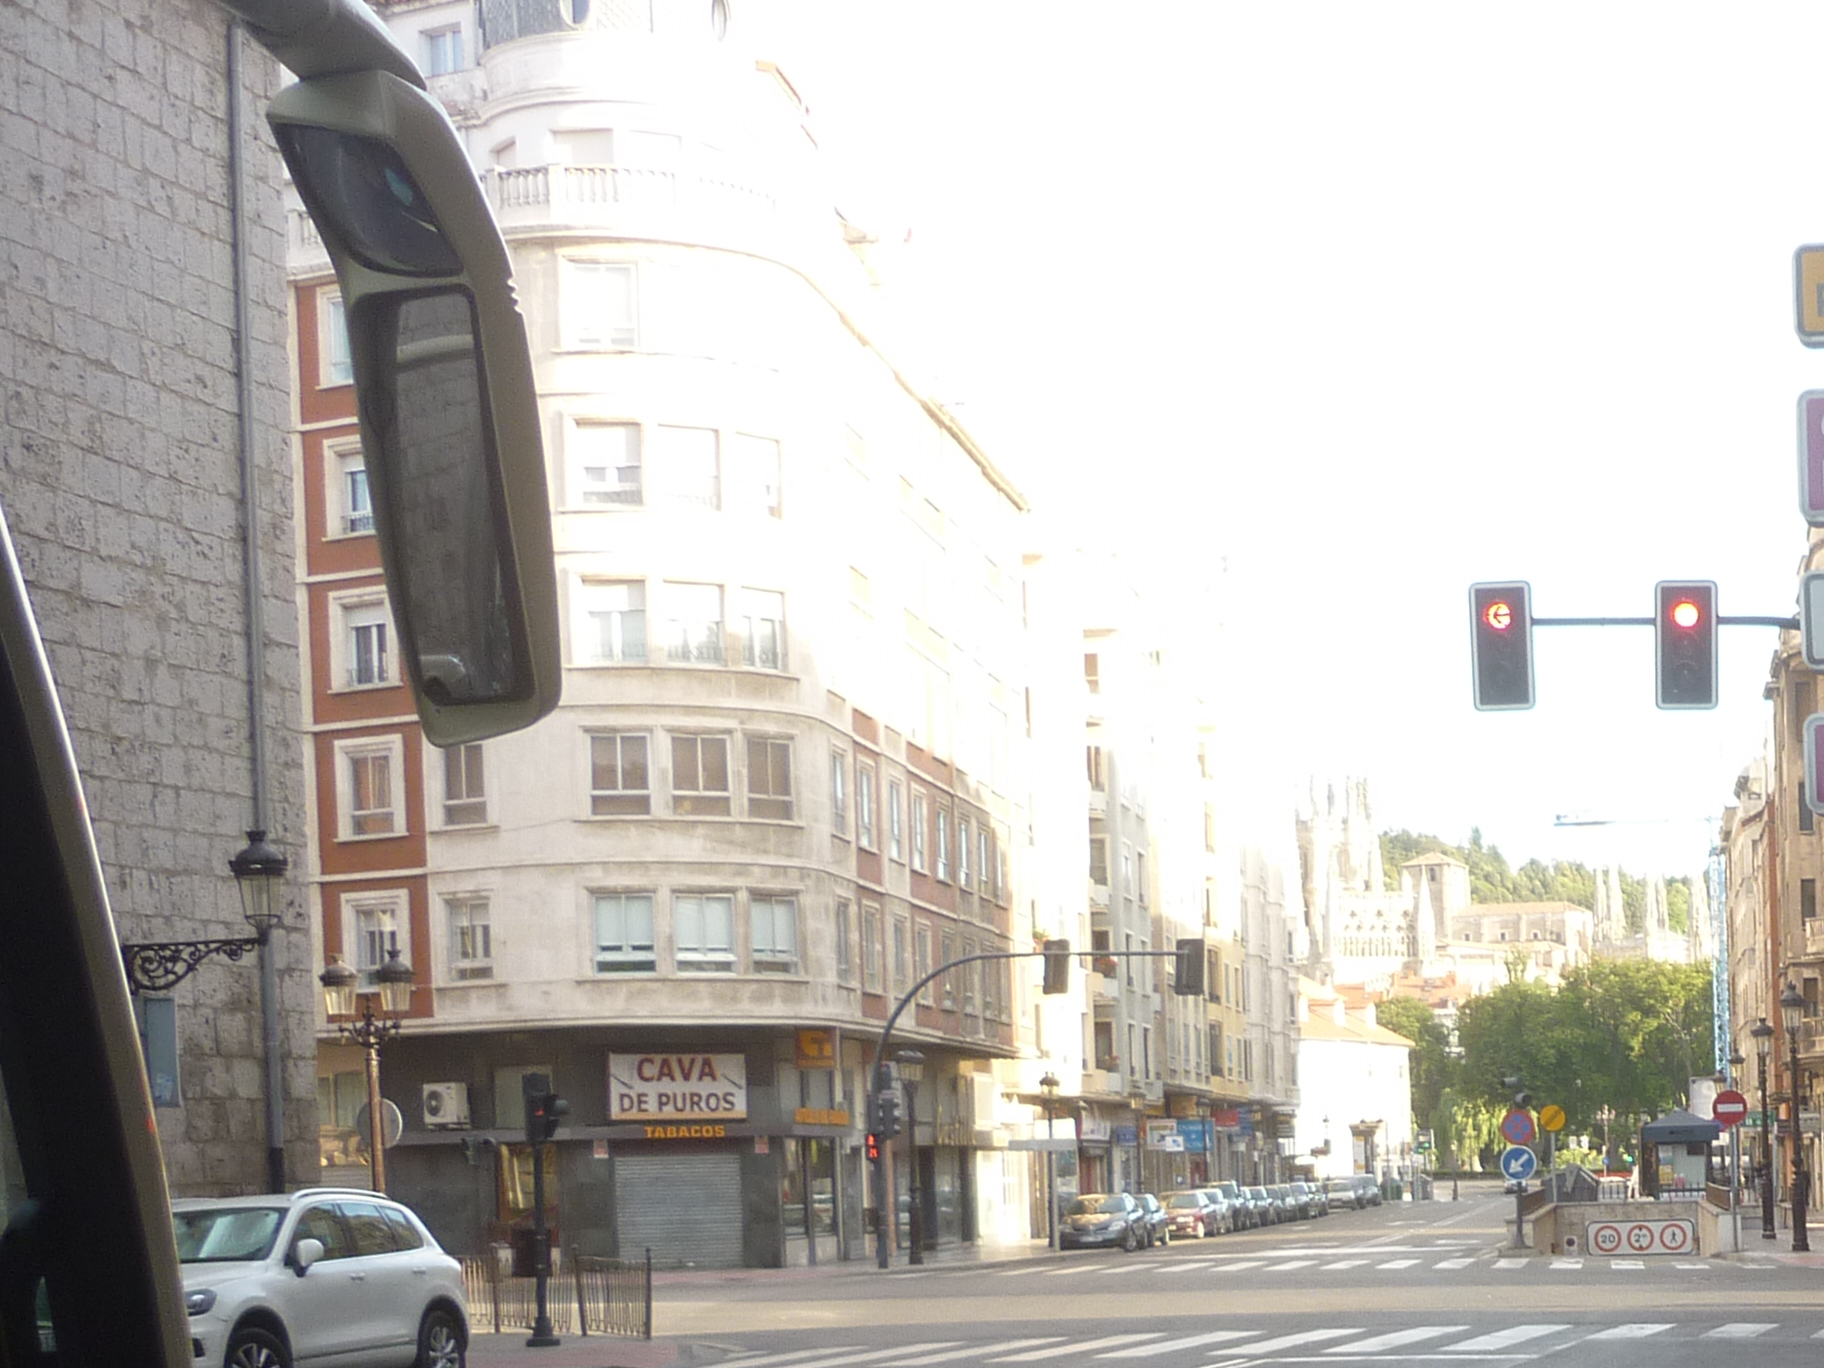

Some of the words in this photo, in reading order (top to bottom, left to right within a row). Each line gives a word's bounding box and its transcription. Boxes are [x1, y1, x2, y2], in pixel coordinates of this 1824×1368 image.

[636, 1056, 718, 1083] CAVA
[619, 1092, 649, 1113] DE
[657, 1091, 736, 1113] PUROS
[644, 1124, 726, 1139] TABACOS
[1600, 1233, 1616, 1244] 20
